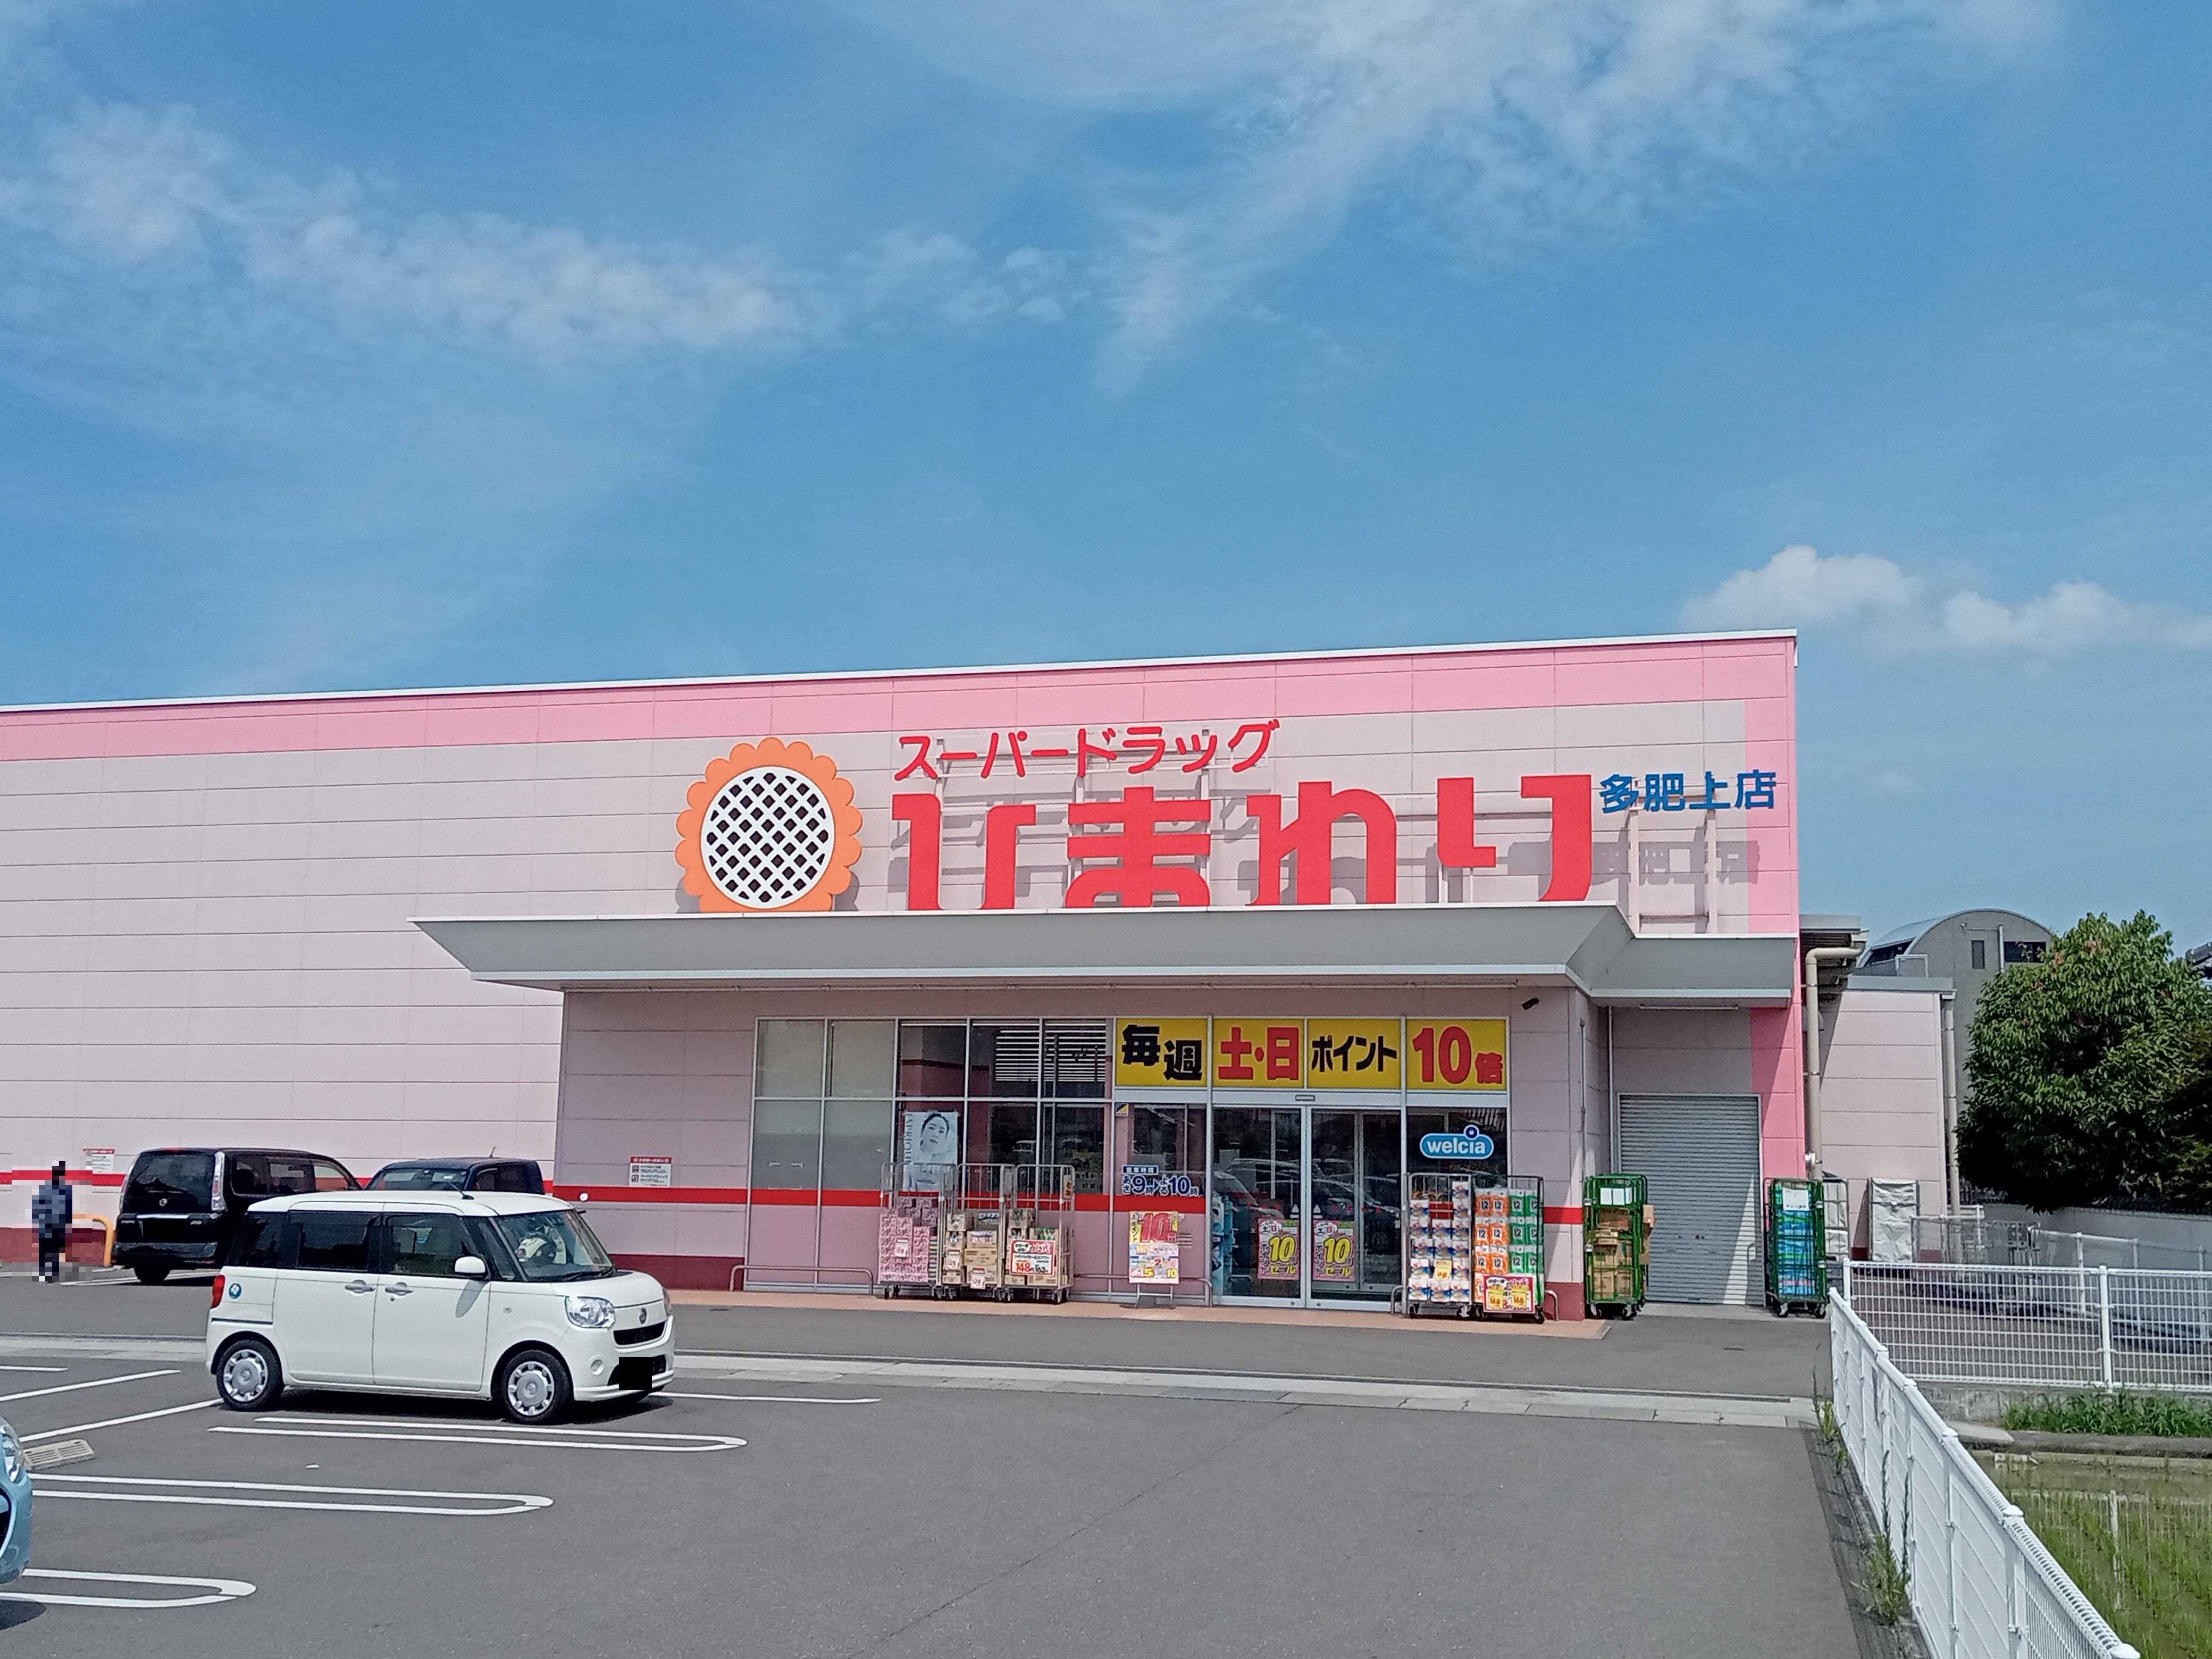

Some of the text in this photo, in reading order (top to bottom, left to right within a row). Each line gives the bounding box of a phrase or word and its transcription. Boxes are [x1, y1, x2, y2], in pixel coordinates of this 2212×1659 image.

[894, 719, 1280, 781] スーパードラッグ
[1599, 769, 1777, 815] 多肥上店
[1121, 1025, 1203, 1080] 毎週
[1311, 1035, 1397, 1073] ポイント
[1412, 1026, 1503, 1084] 10倍
[1427, 1137, 1485, 1154] welcia
[1481, 1201, 1488, 1211] 12
[1495, 1201, 1502, 1210] 12
[1513, 1201, 1521, 1209] 12
[1479, 1229, 1486, 1238] 12
[1494, 1229, 1501, 1238] 12
[1514, 1228, 1521, 1237] 12
[1478, 1258, 1485, 1266] 12
[1494, 1259, 1501, 1268] 12
[1513, 1258, 1521, 1266] 12
